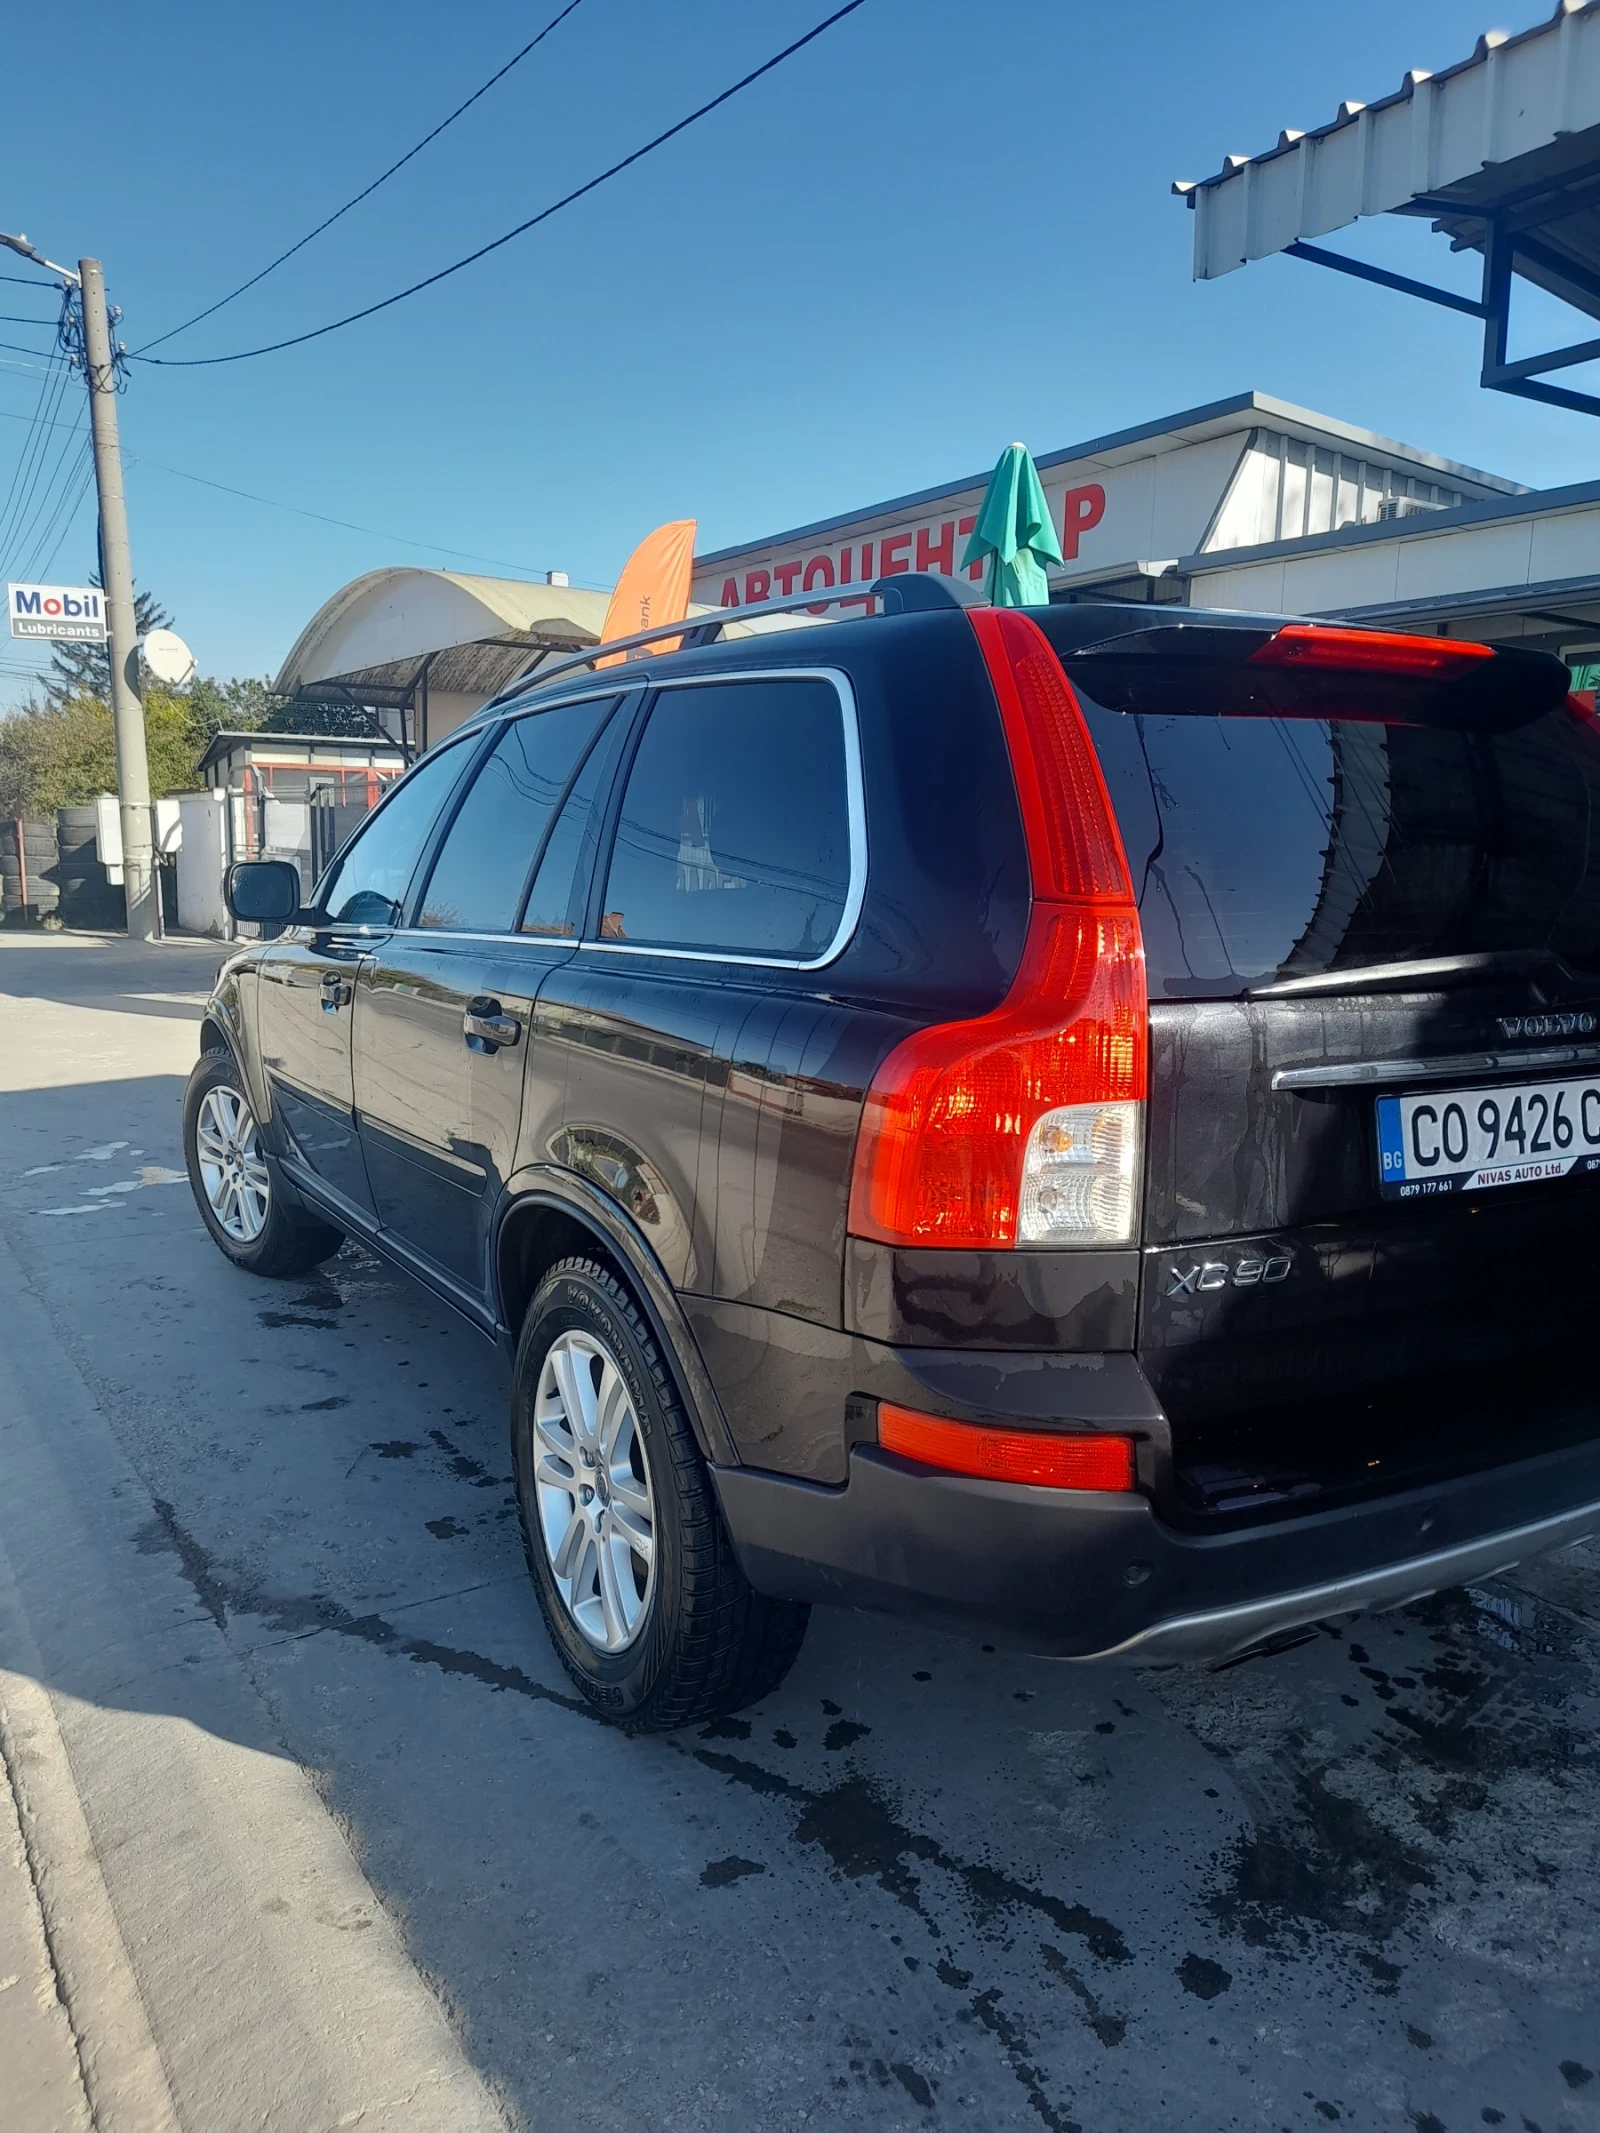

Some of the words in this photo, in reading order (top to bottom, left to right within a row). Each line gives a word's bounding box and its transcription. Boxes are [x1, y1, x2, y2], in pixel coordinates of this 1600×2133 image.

[16, 591, 99, 617] Mobil
[640, 595, 651, 632] ank
[18, 622, 100, 637] Lubricants
[1498, 1012, 1596, 1038] VOLVO
[1383, 1151, 1402, 1170] BG
[1477, 1169, 1511, 1185] NIVAS
[1514, 1164, 1542, 1180] AUTO
[1545, 1161, 1565, 1175] Ltd.
[1400, 1184, 1421, 1197] 0879
[1423, 1182, 1437, 1193] 177
[1438, 1180, 1453, 1191] 661
[1164, 1256, 1292, 1297] XC90
[567, 1284, 652, 1437] YOKOHAMA
